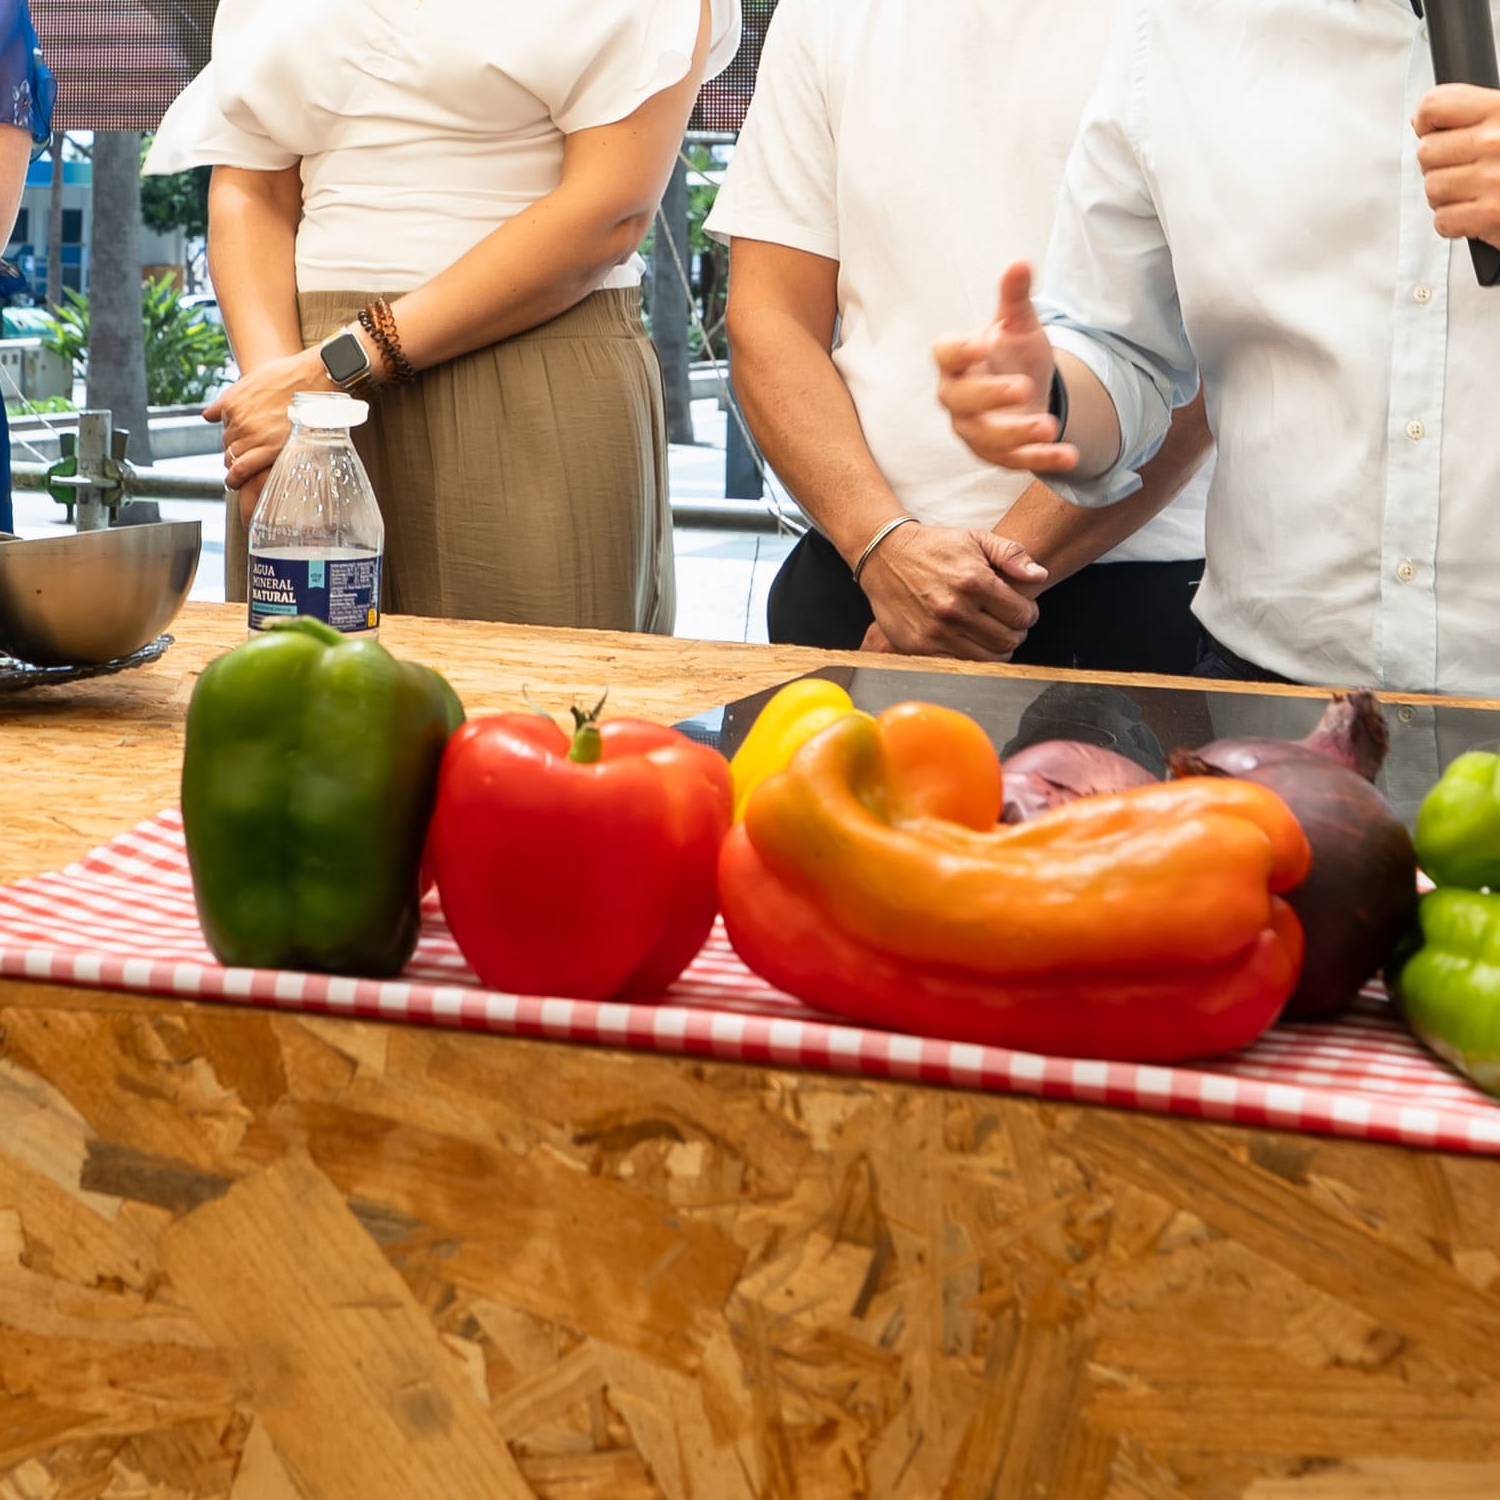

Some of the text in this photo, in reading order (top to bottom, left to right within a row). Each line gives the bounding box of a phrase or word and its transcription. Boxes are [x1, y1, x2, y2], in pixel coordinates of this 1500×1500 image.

[252, 563, 275, 577] AGUA
[252, 575, 294, 591] MINERAL
[252, 588, 297, 604] NATURAL
